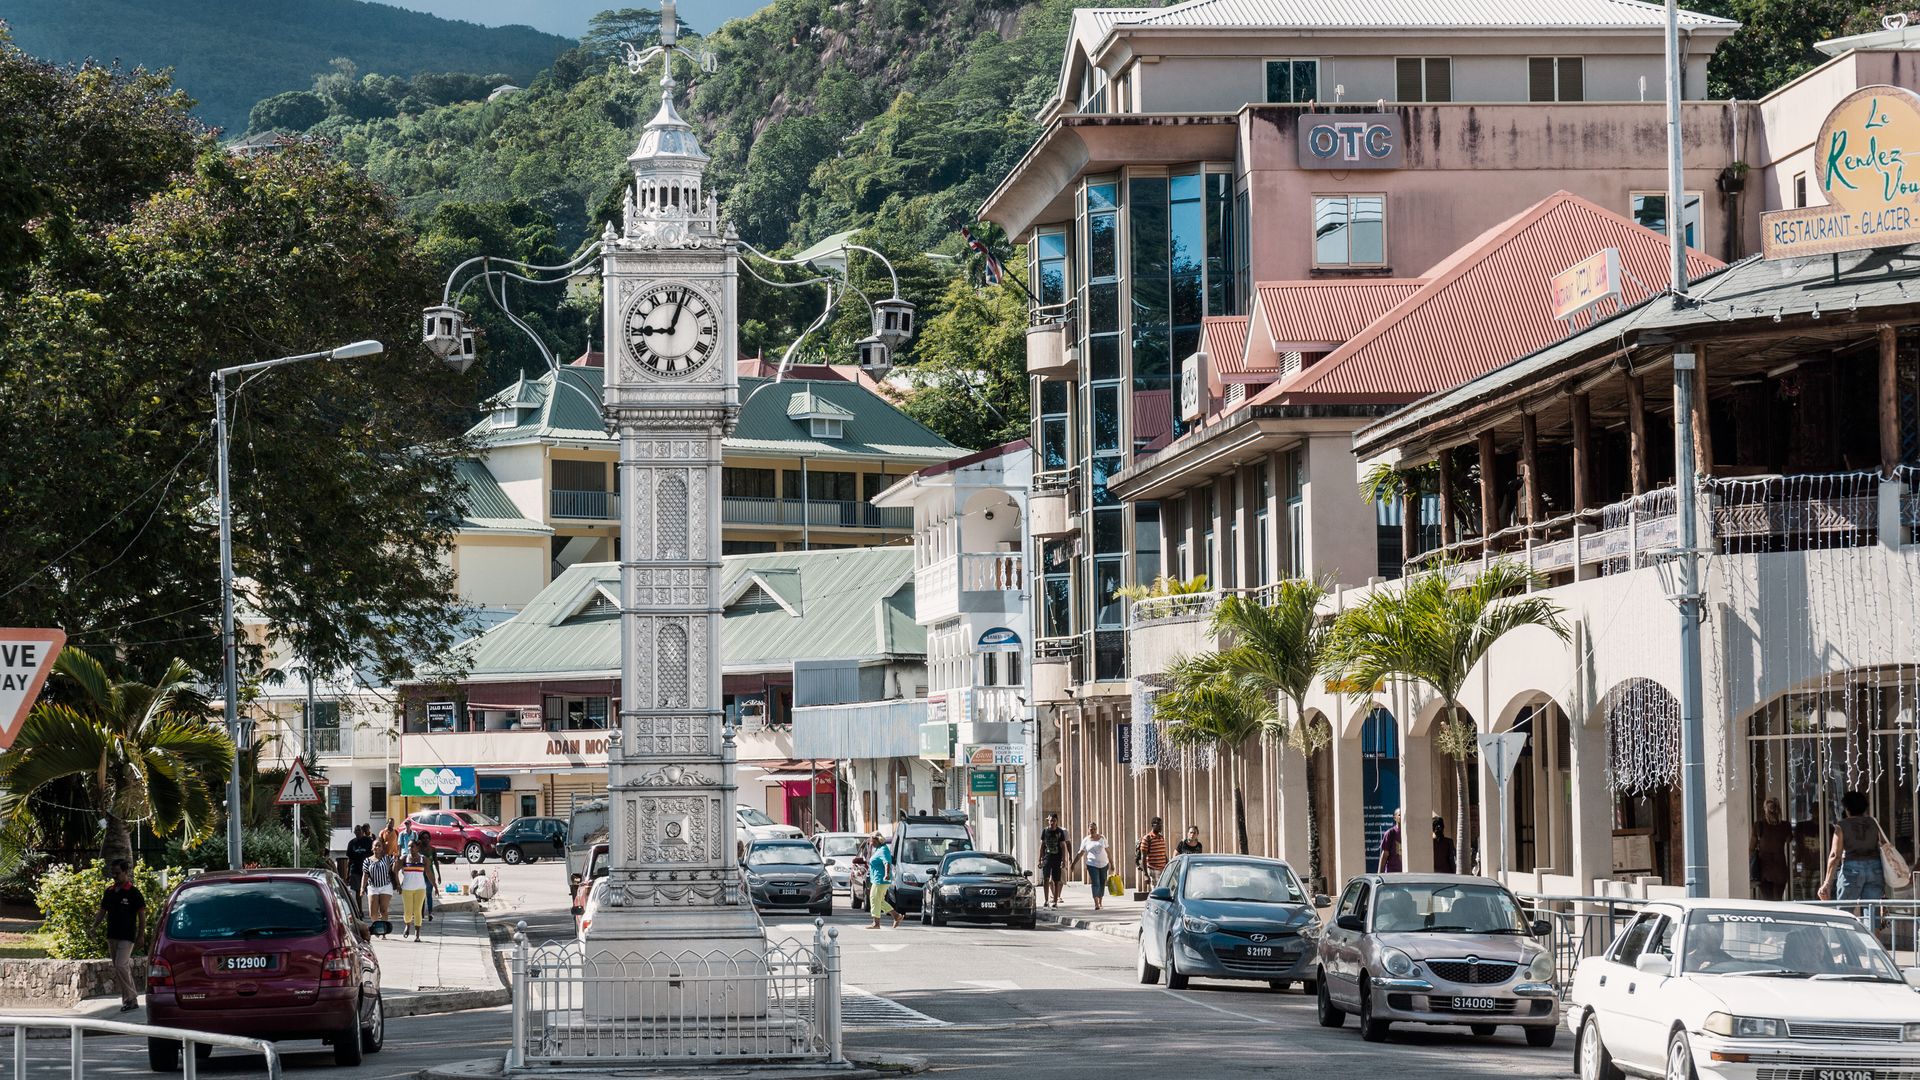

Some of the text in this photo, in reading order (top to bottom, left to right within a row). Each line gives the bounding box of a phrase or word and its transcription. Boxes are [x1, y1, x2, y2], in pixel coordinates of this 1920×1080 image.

[1865, 98, 1890, 129] Le
[1309, 122, 1393, 160] OTC
[1825, 130, 1904, 191] Rendez
[1883, 165, 1920, 201] Vou
[1774, 214, 1851, 245] RESTAURANT
[1861, 206, 1911, 235] GLACIER
[1, 644, 36, 668] VE
[0, 673, 28, 691] AY
[546, 739, 609, 755] ADAM MOO
[1720, 914, 1775, 923] TOYOTA
[1454, 996, 1494, 1009] S14009
[1819, 1070, 1872, 1080] S19306
